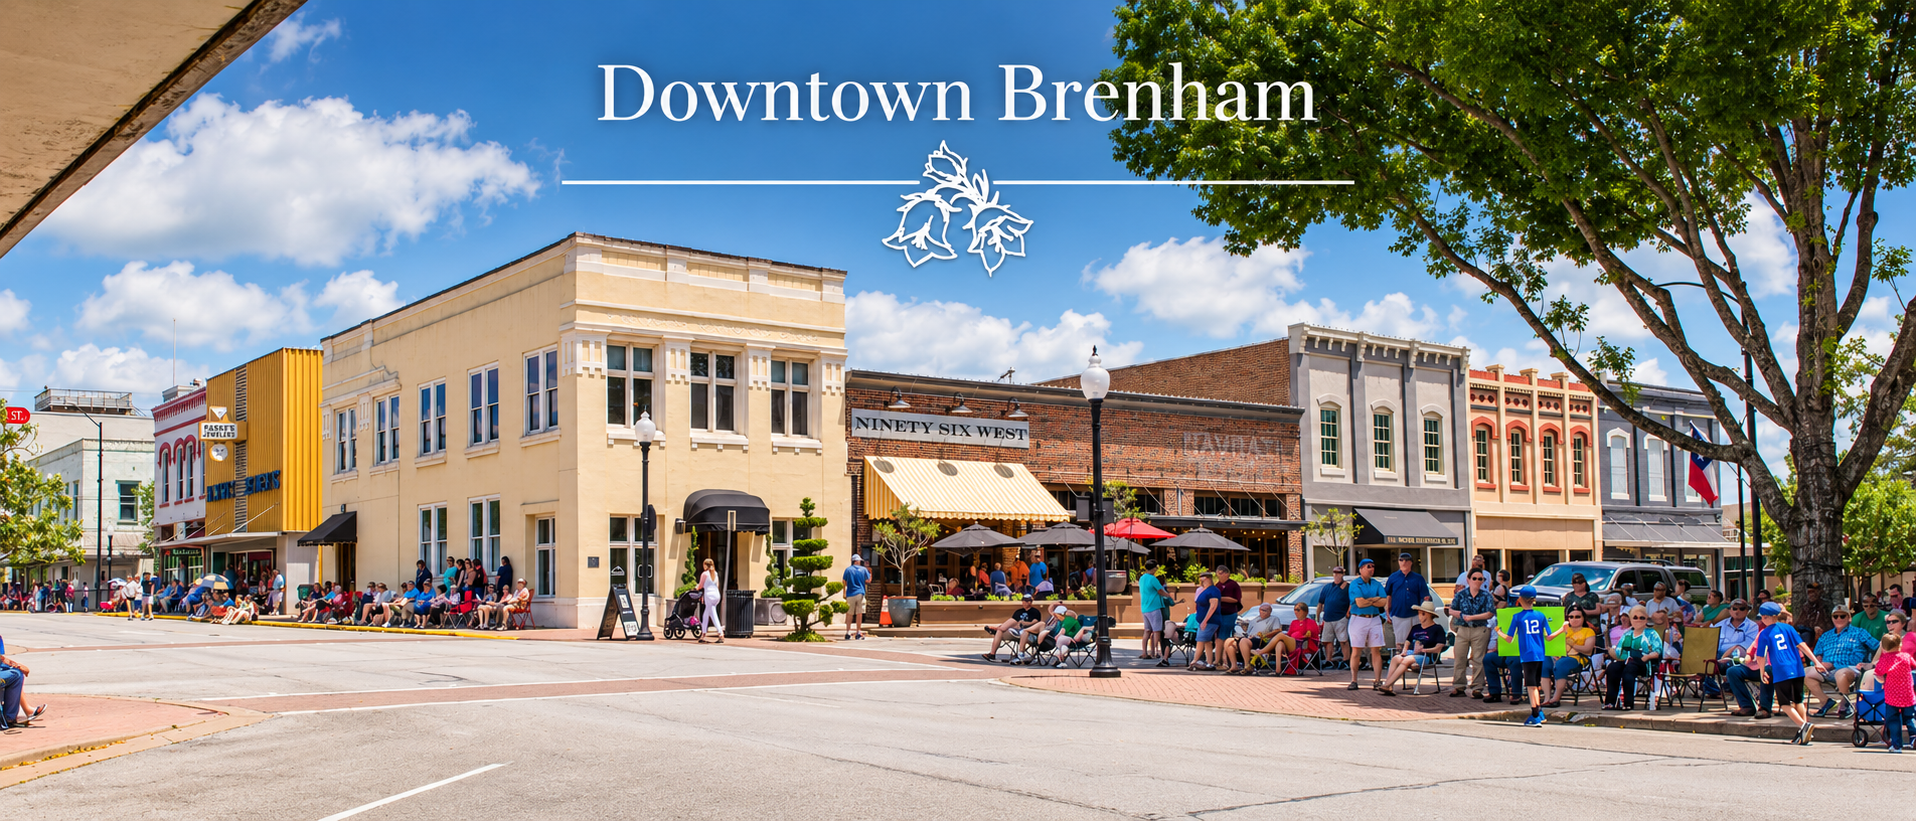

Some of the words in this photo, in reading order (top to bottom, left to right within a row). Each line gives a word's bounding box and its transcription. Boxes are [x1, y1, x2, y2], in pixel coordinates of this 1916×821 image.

[854, 416, 934, 435] NINETY
[938, 422, 972, 438] SIX
[976, 425, 1028, 441] WEST
[1524, 619, 1540, 635] 12
[1774, 633, 1788, 651] 2
